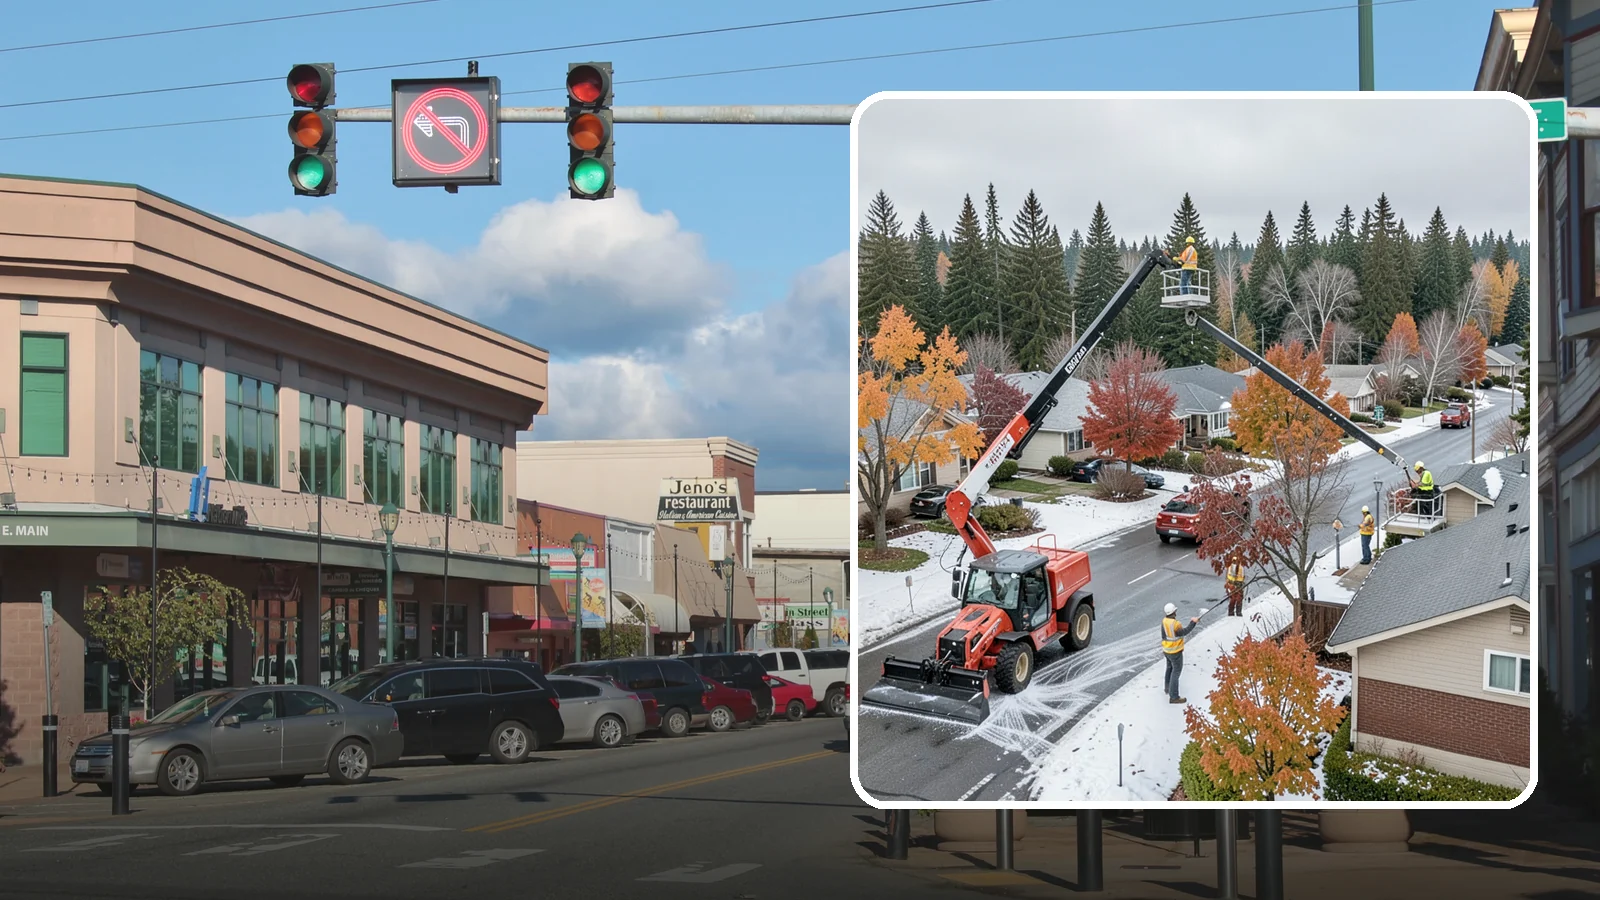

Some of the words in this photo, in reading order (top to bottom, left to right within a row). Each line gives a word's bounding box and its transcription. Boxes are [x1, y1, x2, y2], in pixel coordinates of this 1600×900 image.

[669, 479, 728, 495] Jeno's
[665, 496, 731, 509] restaurant
[659, 509, 681, 520] Italian
[685, 509, 715, 520] American
[715, 509, 737, 520] Cuisine
[2, 525, 13, 536] E.
[15, 525, 49, 536] MAIN
[797, 607, 828, 617] Street
[790, 619, 824, 627] lass
